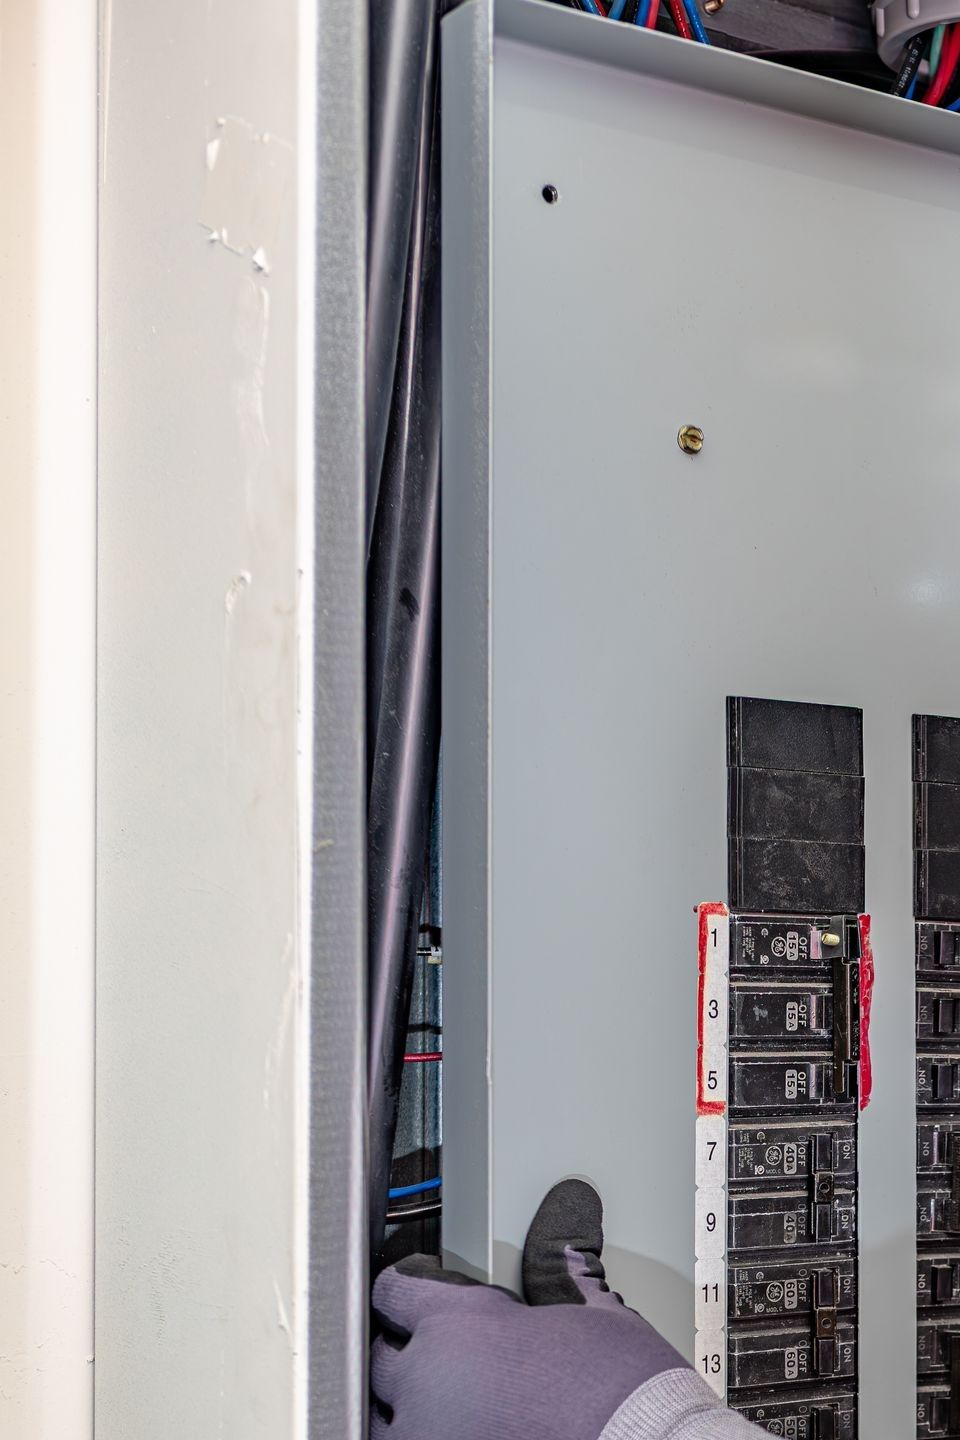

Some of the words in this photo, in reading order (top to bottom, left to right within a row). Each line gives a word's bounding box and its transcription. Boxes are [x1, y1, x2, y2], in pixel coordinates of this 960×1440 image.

[710, 928, 718, 946] 1
[798, 937, 807, 960] OFF
[709, 1000, 718, 1019] 3
[798, 1004, 807, 1027] OFF
[708, 1071, 718, 1089] 5
[798, 1072, 806, 1095] OFF
[706, 1141, 717, 1161] 7
[706, 1212, 716, 1232] 9
[701, 1283, 719, 1303] 11
[702, 1353, 721, 1374] 13
